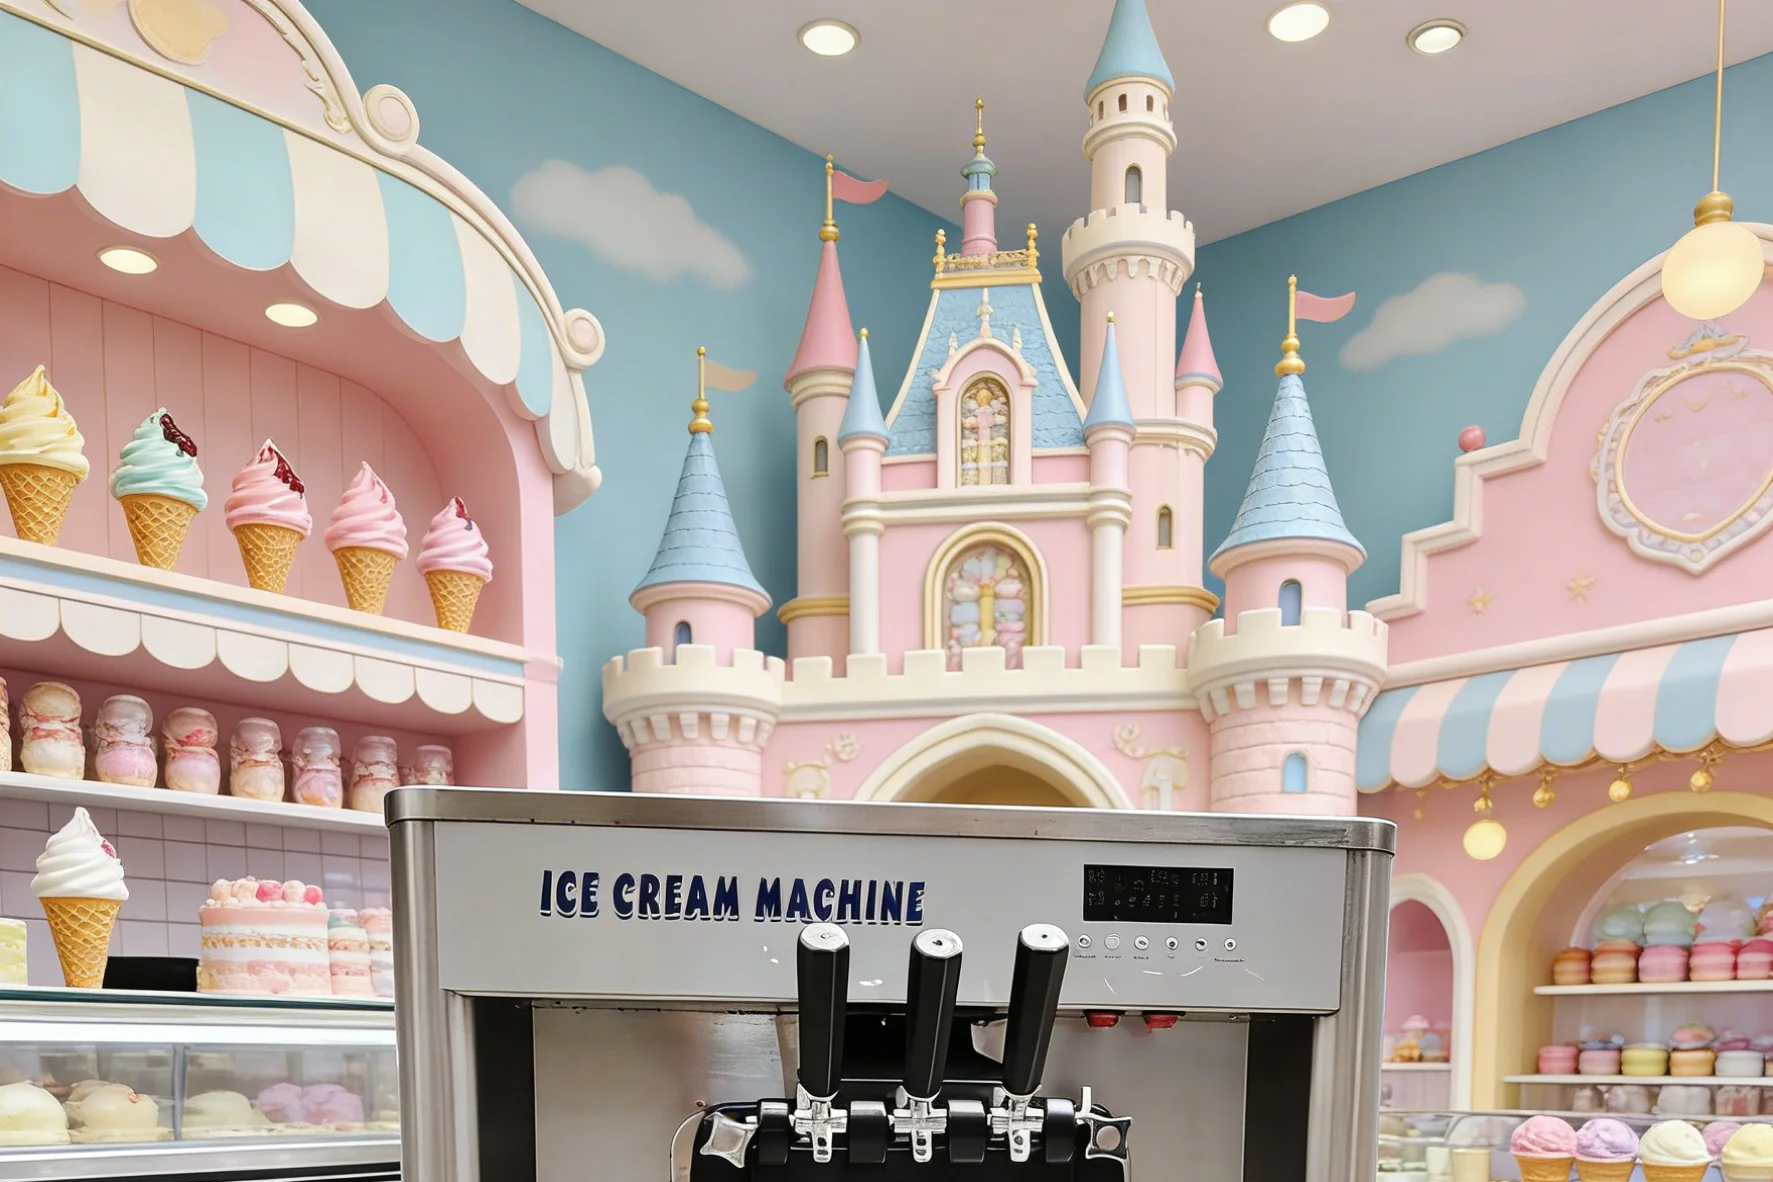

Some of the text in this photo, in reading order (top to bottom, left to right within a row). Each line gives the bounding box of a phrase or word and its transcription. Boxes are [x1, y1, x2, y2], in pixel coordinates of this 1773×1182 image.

[539, 869, 926, 926] ICE CREAM MACHINE
